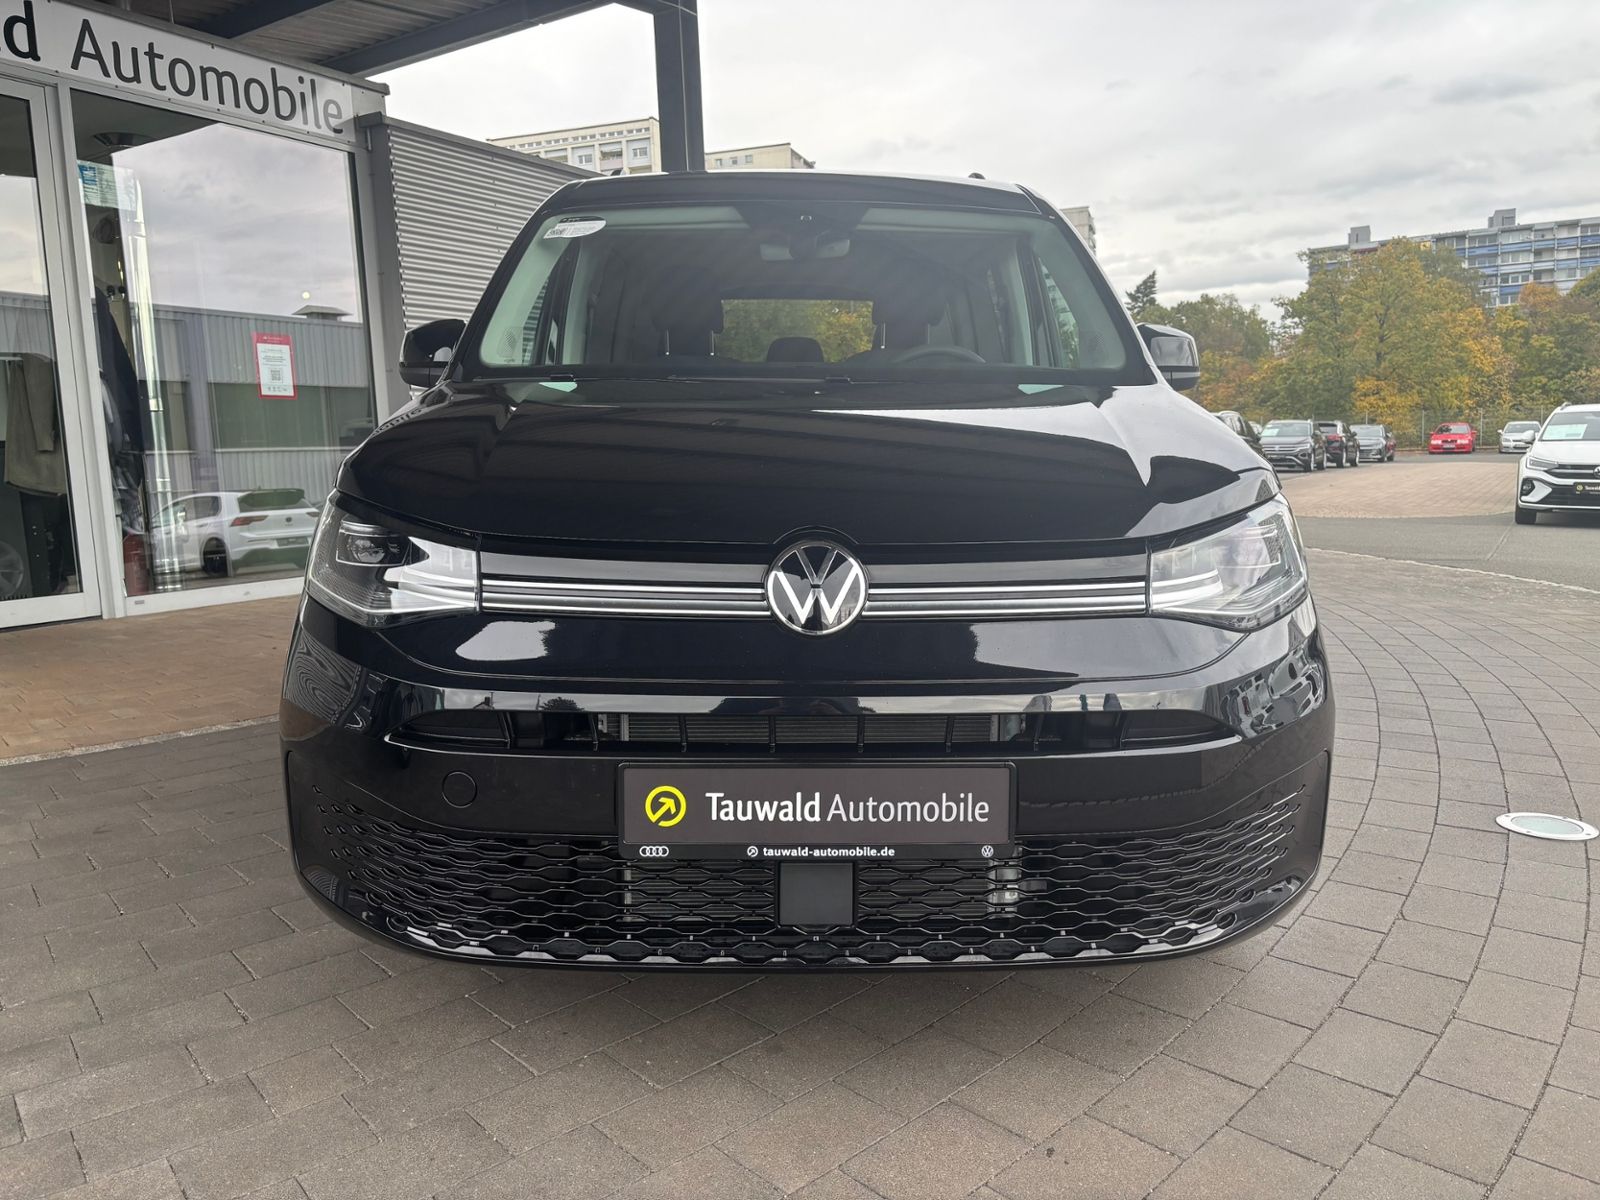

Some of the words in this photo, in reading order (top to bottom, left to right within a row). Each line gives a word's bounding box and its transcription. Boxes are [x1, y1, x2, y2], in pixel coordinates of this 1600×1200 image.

[70, 18, 344, 134] Automobile
[705, 792, 821, 822] Tauwald
[826, 793, 990, 822] Automobile
[762, 846, 896, 857] tauwald-automobile.de
